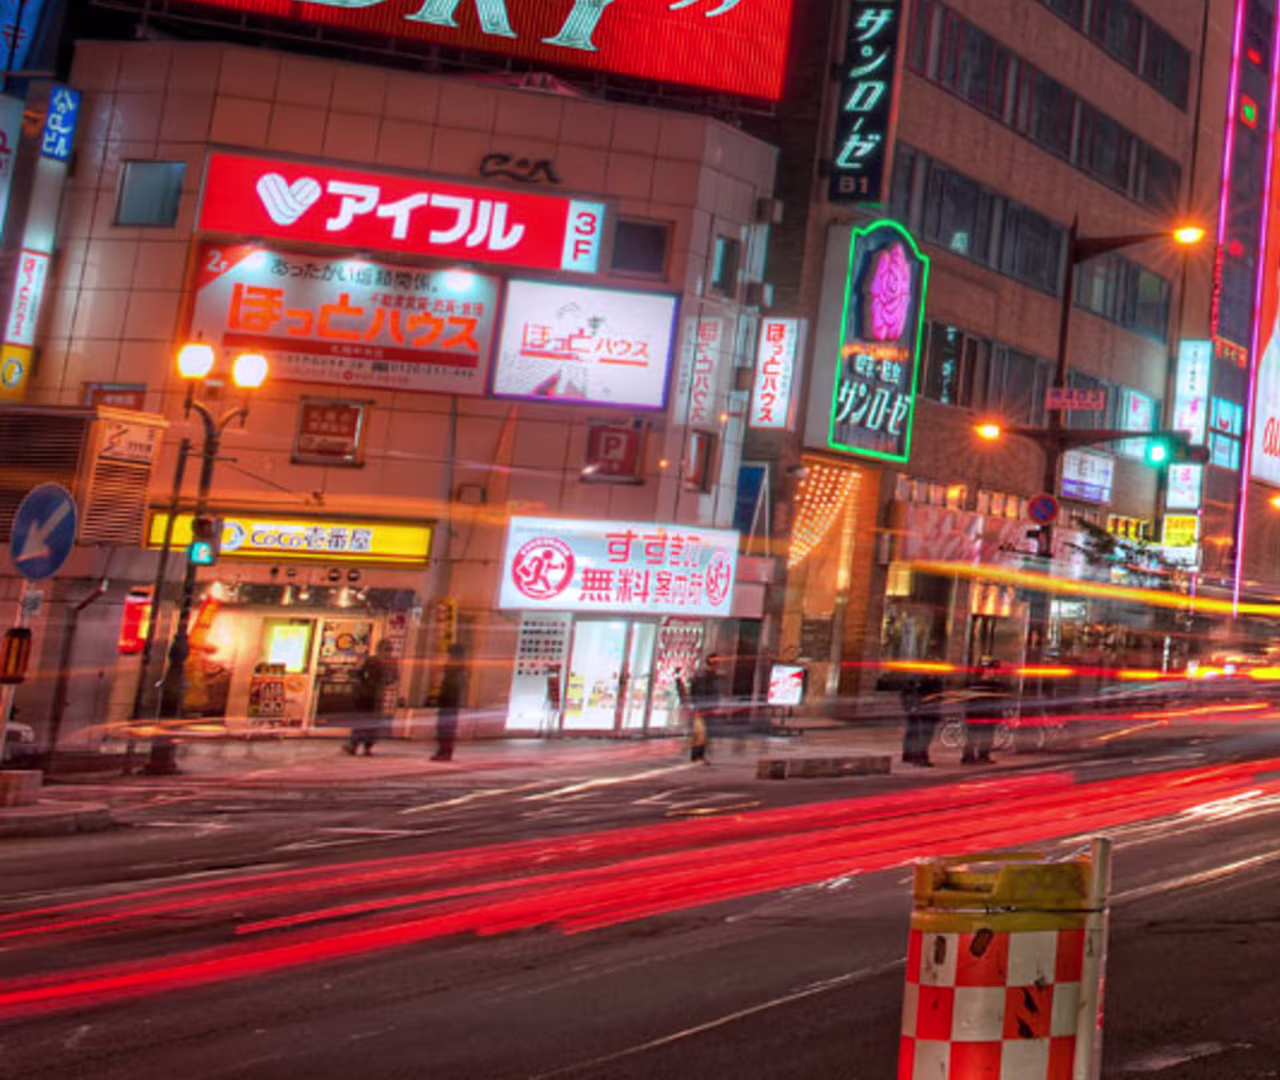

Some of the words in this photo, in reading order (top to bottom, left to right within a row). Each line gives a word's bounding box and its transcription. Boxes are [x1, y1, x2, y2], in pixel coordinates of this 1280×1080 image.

[835, 7, 895, 170] サンローゼ
[324, 178, 526, 252] アイフル
[571, 211, 599, 263] 3F
[226, 282, 481, 352] ほっとハウス
[520, 320, 650, 360] ほっとハウス
[757, 322, 786, 423] ほっとハウス
[602, 432, 628, 465] P
